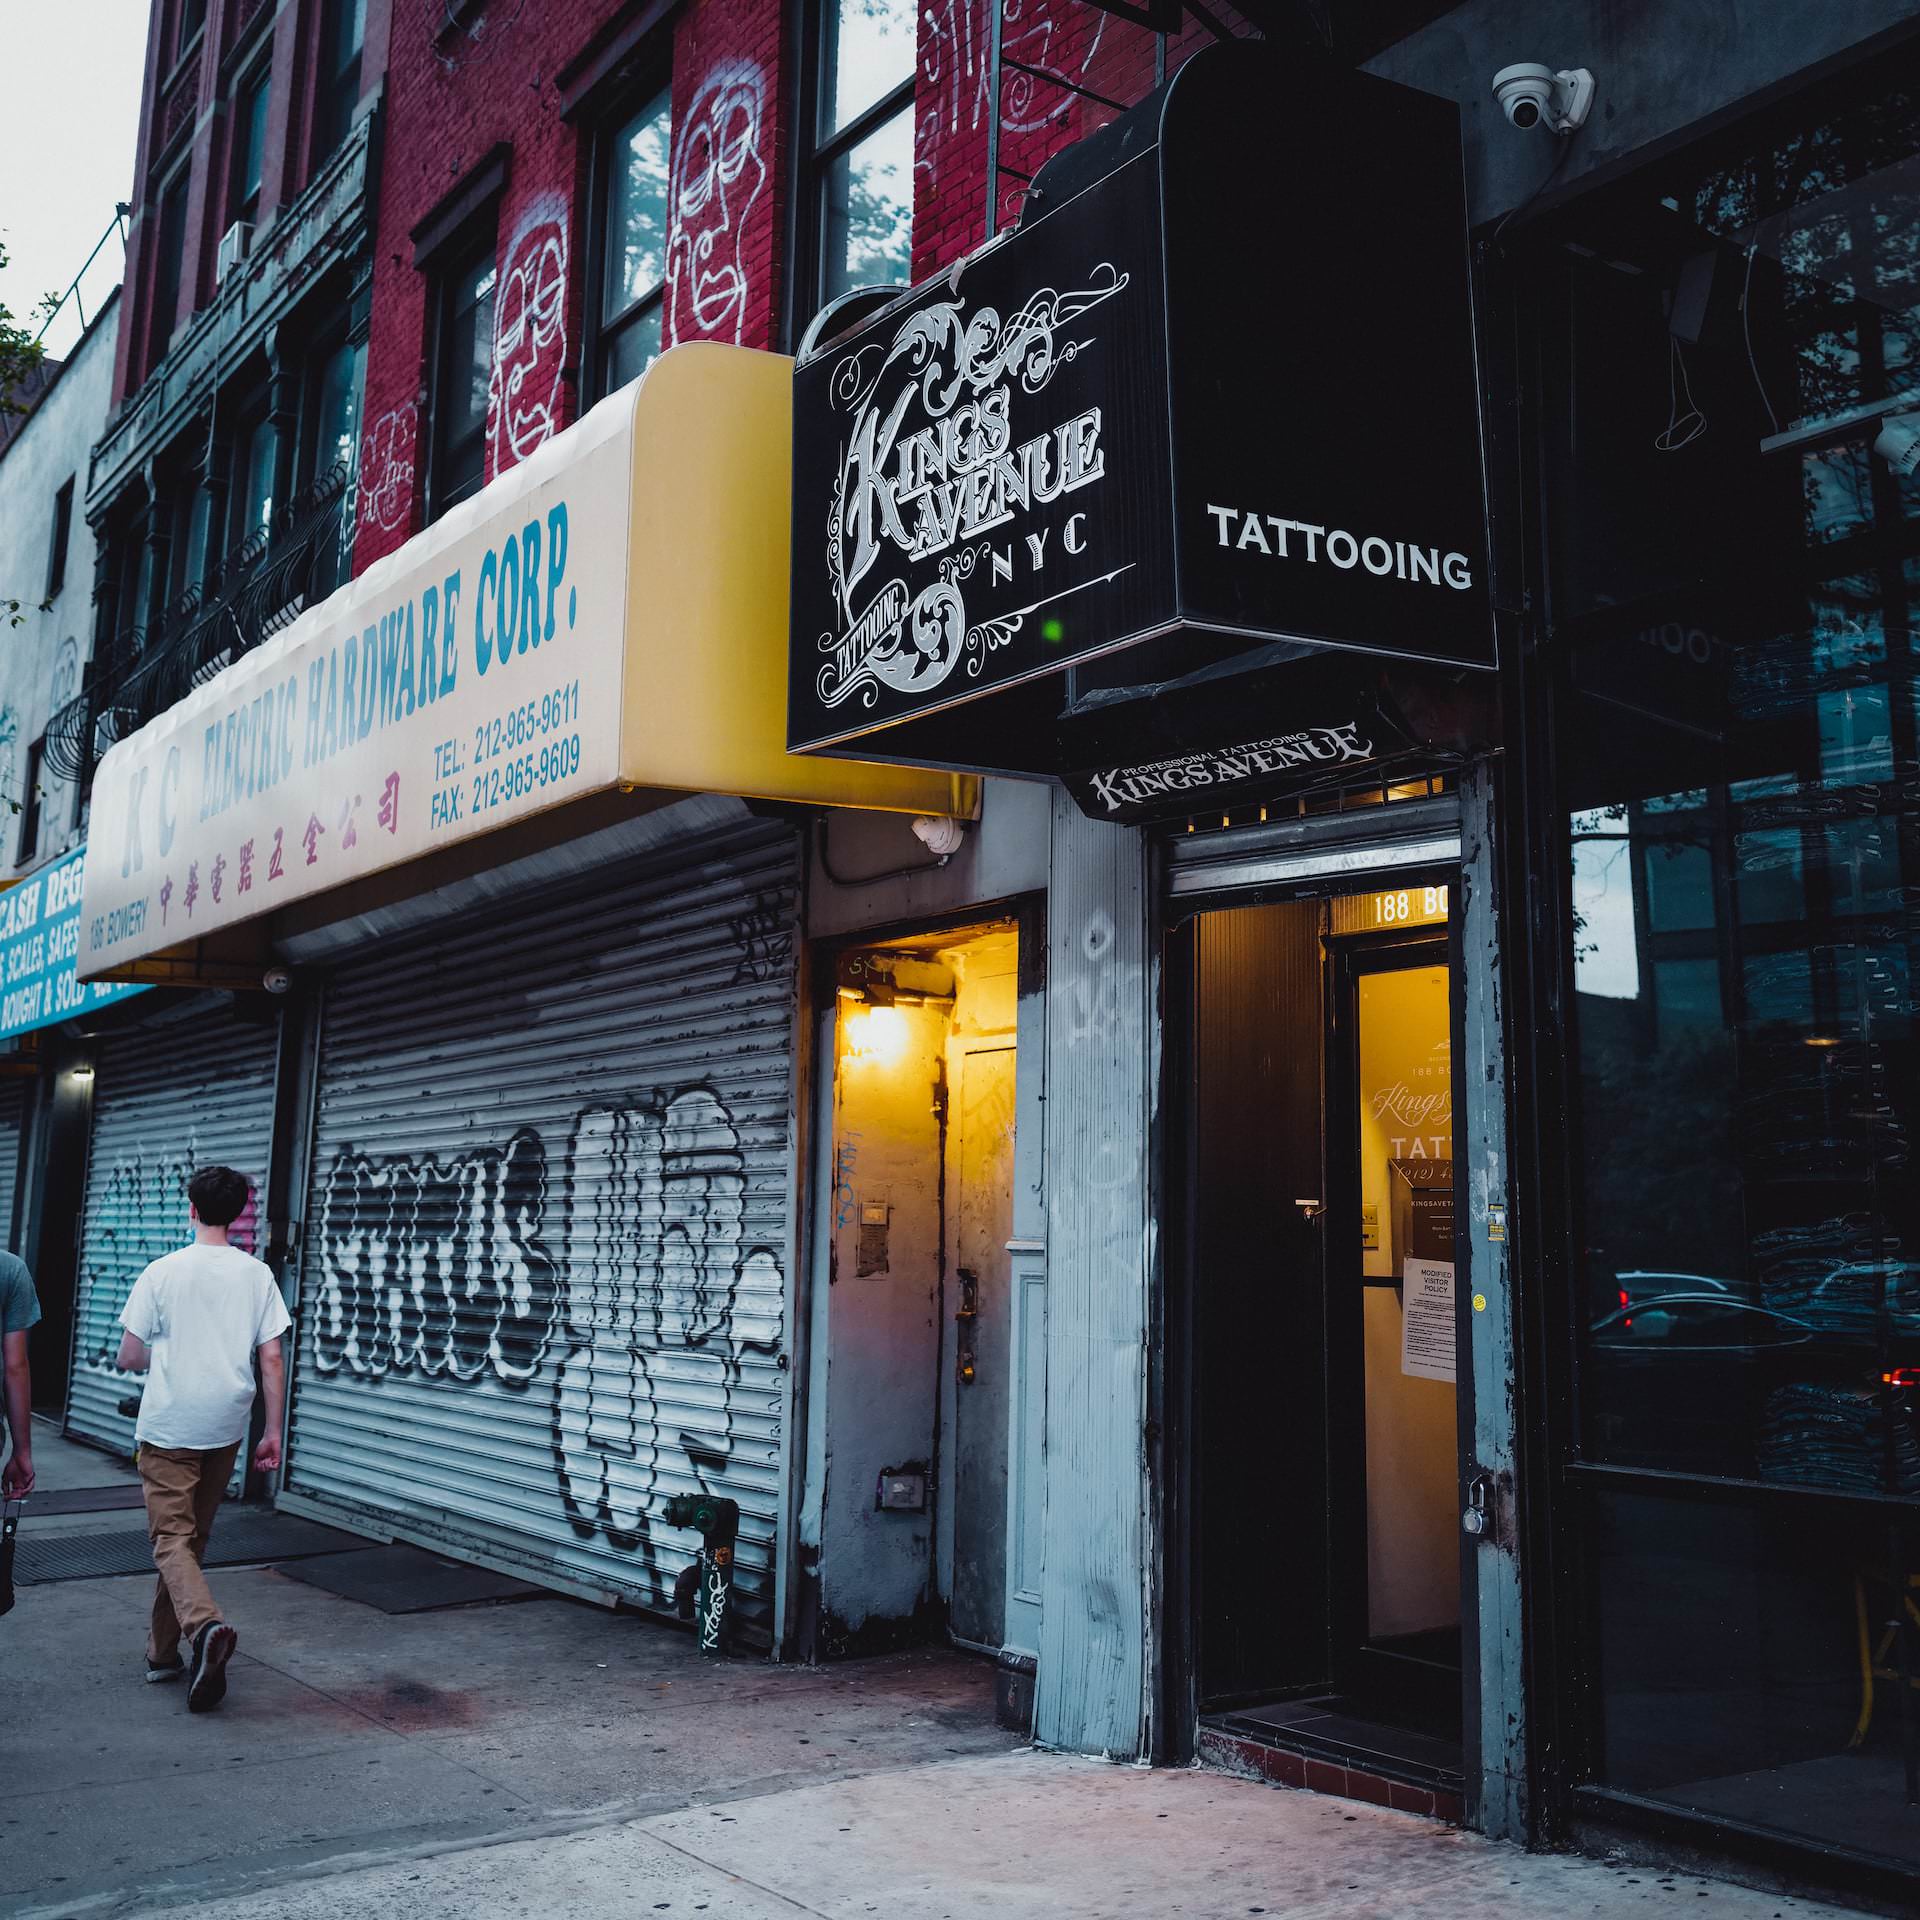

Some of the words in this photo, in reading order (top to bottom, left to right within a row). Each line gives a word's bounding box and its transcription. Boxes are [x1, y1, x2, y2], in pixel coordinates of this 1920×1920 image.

[847, 380, 1011, 592] KINGS
[908, 407, 1105, 563] AVENUE
[1207, 503, 1472, 590] TATTOOING
[837, 585, 900, 683] TATTOOING
[122, 766, 148, 878] K
[159, 746, 181, 858] C
[200, 676, 297, 823] ELECTRIC
[304, 569, 461, 768] HARDWARE
[475, 501, 577, 676] CORP.
[434, 738, 466, 781] TEL:
[474, 679, 579, 764] 212-965-9611
[1123, 751, 1218, 777] PROFESSIONAL
[1220, 732, 1310, 757] TATTOOING
[431, 783, 464, 830] FAX:
[472, 733, 580, 814] 212-965-9609
[1089, 762, 1213, 812] KINGS
[1212, 720, 1373, 782] AVENUE
[45, 854, 84, 919] REG
[1376, 893, 1409, 923] 188
[107, 896, 149, 945] BOWERY
[44, 978, 51, 1016] &
[1374, 1081, 1449, 1127] Kings
[1391, 1135, 1452, 1160] TAT
[1420, 1268, 1452, 1279] MODIFIED
[1424, 1277, 1449, 1287] VISITOR
[1424, 1284, 1448, 1294] POLICY
